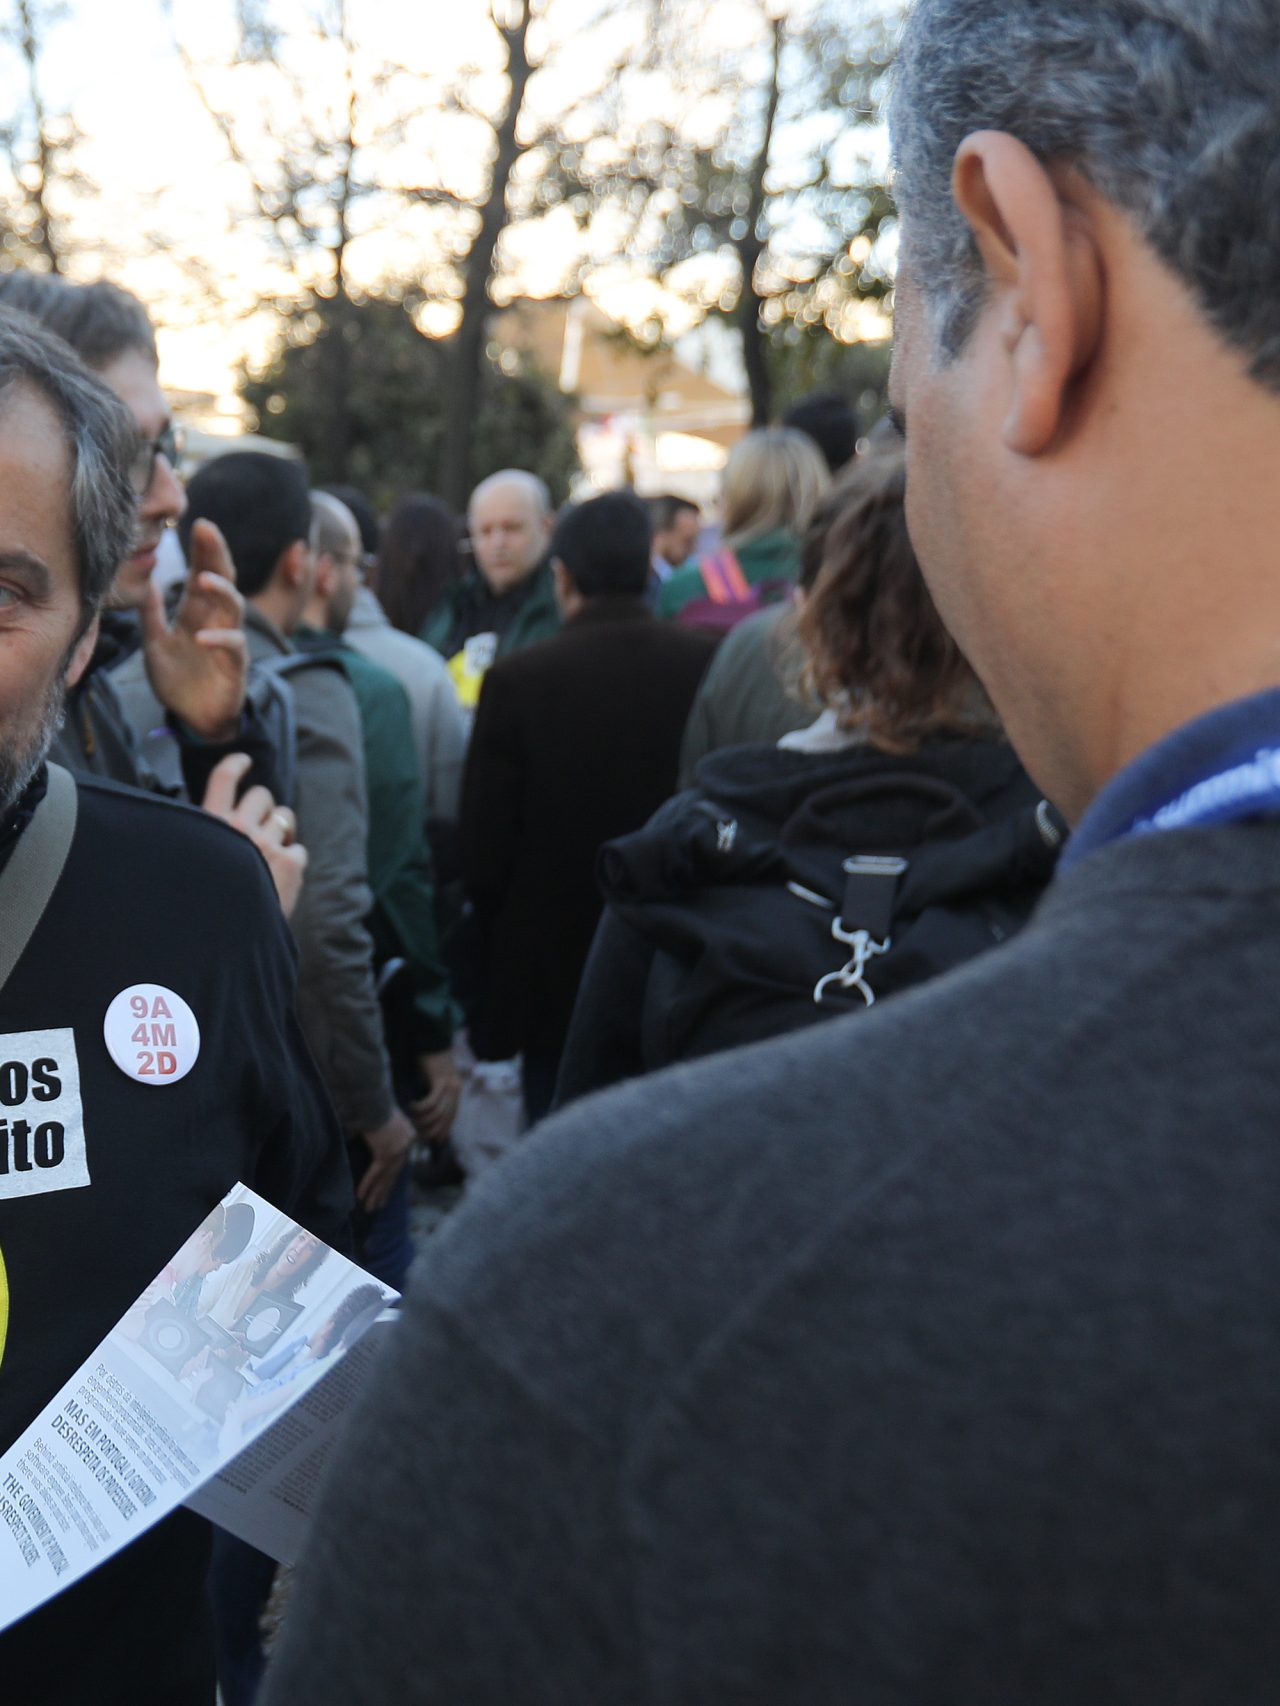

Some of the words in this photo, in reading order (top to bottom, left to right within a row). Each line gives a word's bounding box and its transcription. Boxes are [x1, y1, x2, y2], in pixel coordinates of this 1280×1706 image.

[130, 995, 173, 1018] 9A
[131, 1023, 177, 1046] 4M
[136, 1051, 177, 1075] 2D
[50, 1413, 101, 1473] DESRESPEITA
[94, 1464, 110, 1484] OS
[63, 1398, 89, 1427] MAS
[83, 1420, 102, 1441] EM
[95, 1433, 131, 1476] PORTUGAL
[1, 1471, 24, 1499] THE
